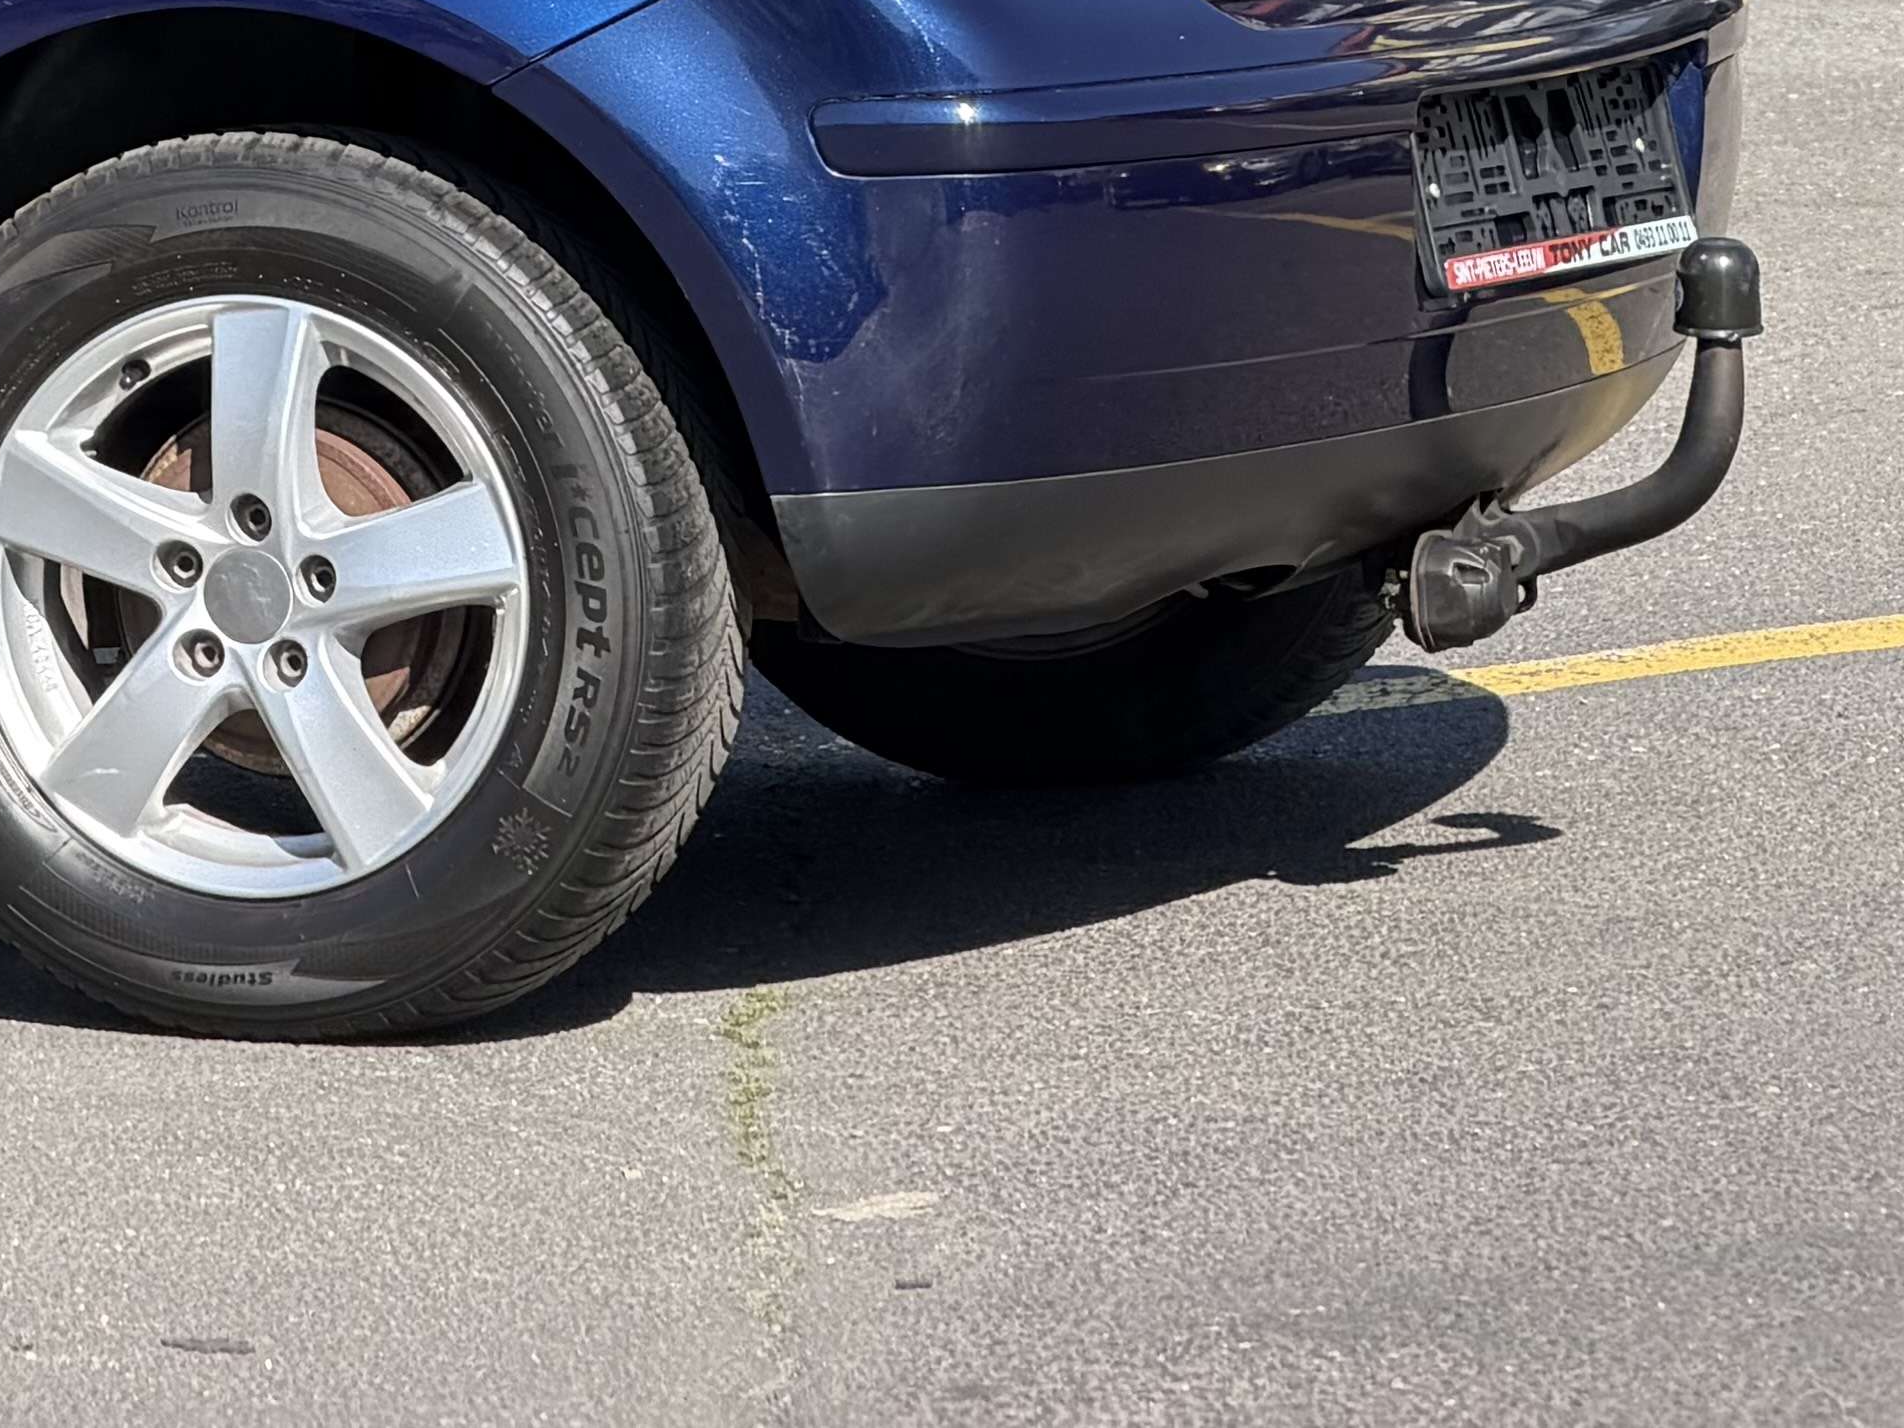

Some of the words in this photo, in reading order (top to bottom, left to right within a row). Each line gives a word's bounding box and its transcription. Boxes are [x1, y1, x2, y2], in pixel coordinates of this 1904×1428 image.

[1549, 238, 1594, 266] TONY
[1600, 230, 1631, 257] CAR
[170, 967, 273, 990] Studless
